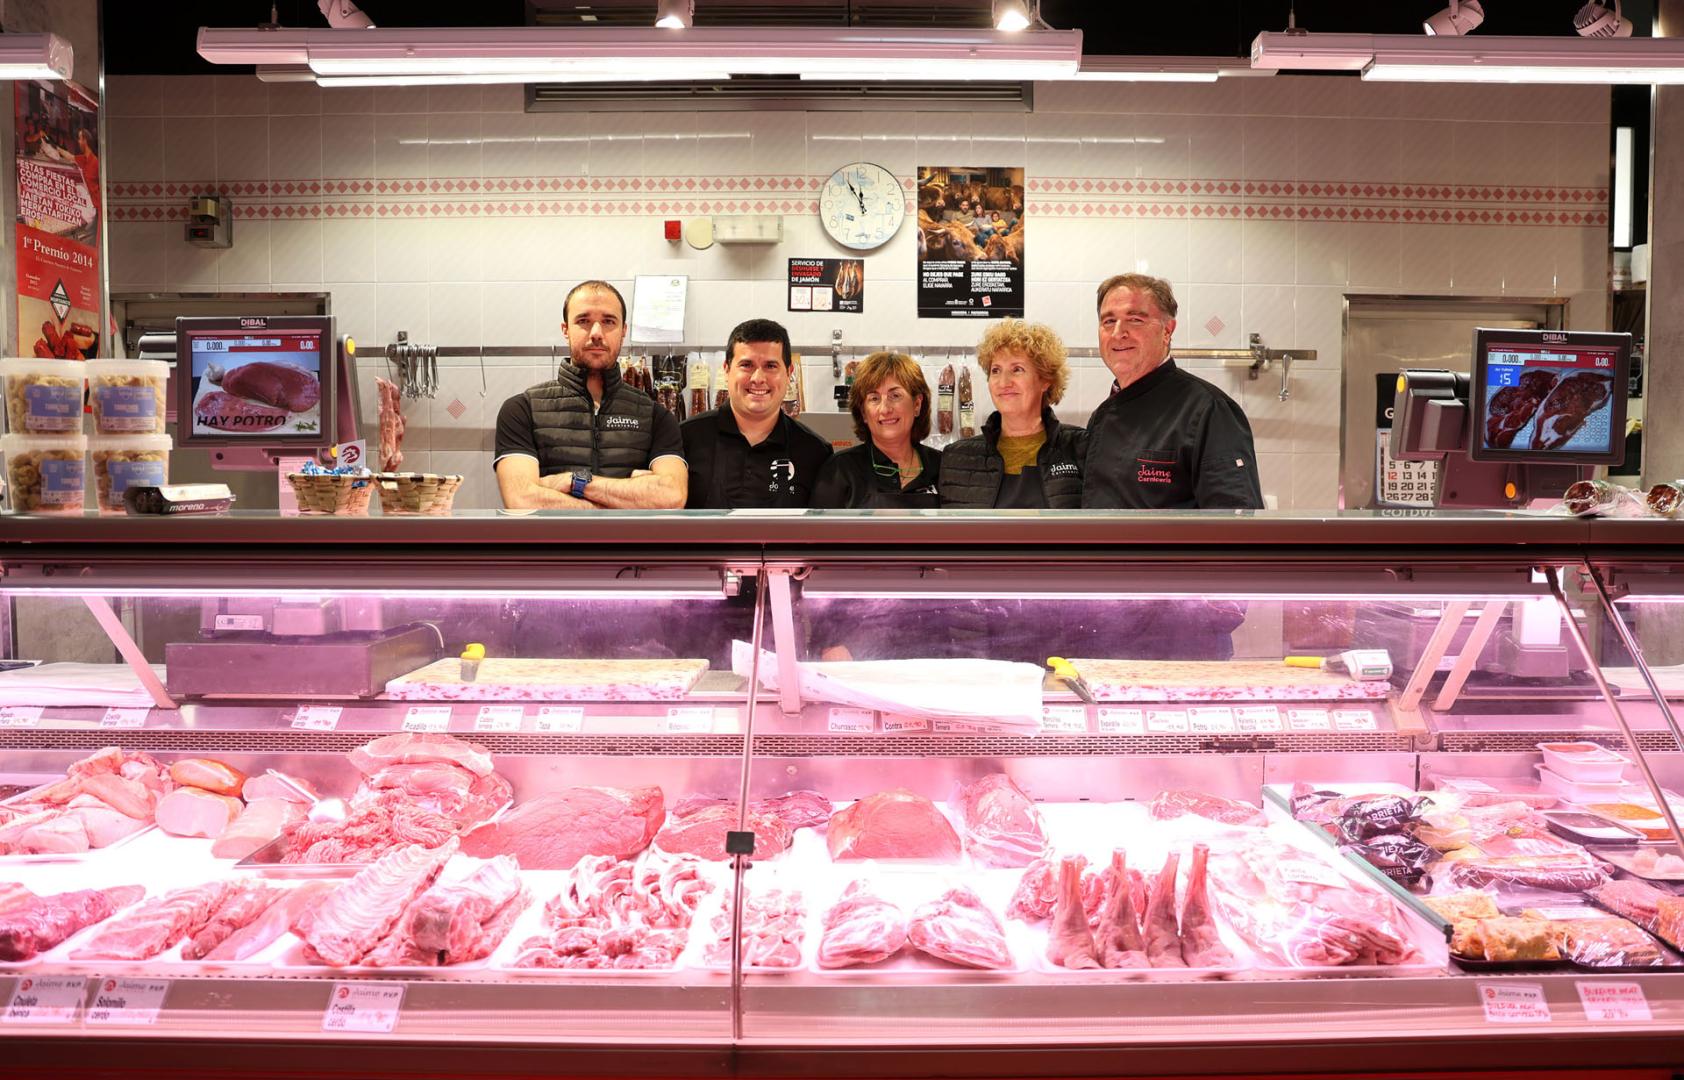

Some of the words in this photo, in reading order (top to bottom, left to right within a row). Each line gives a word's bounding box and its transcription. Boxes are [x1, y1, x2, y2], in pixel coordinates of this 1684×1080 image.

[20, 160, 44, 175] ESTAS
[20, 168, 54, 187] COMPRA
[55, 181, 65, 191] EN
[67, 185, 77, 195] EL
[20, 176, 61, 197] COMERCIO
[63, 191, 87, 206] LOCAL
[33, 239, 70, 261] Premio
[72, 251, 93, 268] 2014
[799, 276, 819, 284] JAMÓN
[241, 318, 266, 327] DIBAL
[1542, 333, 1567, 341] DIBAL
[1500, 373, 1511, 385] 15
[197, 415, 232, 426] HAY
[233, 415, 287, 426] POTRO
[606, 416, 639, 425] Jaime
[1389, 461, 1396, 469] 5
[1403, 461, 1411, 469] 6
[1137, 465, 1171, 477] Jaime
[1387, 472, 1397, 480] 12
[1402, 472, 1412, 480] 13
[1417, 472, 1427, 480] 14
[1388, 482, 1398, 491] 19
[1401, 482, 1414, 491] 20
[1417, 482, 1427, 491] 21
[1386, 493, 1399, 501] 26
[1400, 493, 1413, 501] 27
[1415, 493, 1429, 501] 28
[169, 503, 205, 512] moreno
[885, 722, 903, 730] Contra
[1366, 803, 1404, 821] RRIETA
